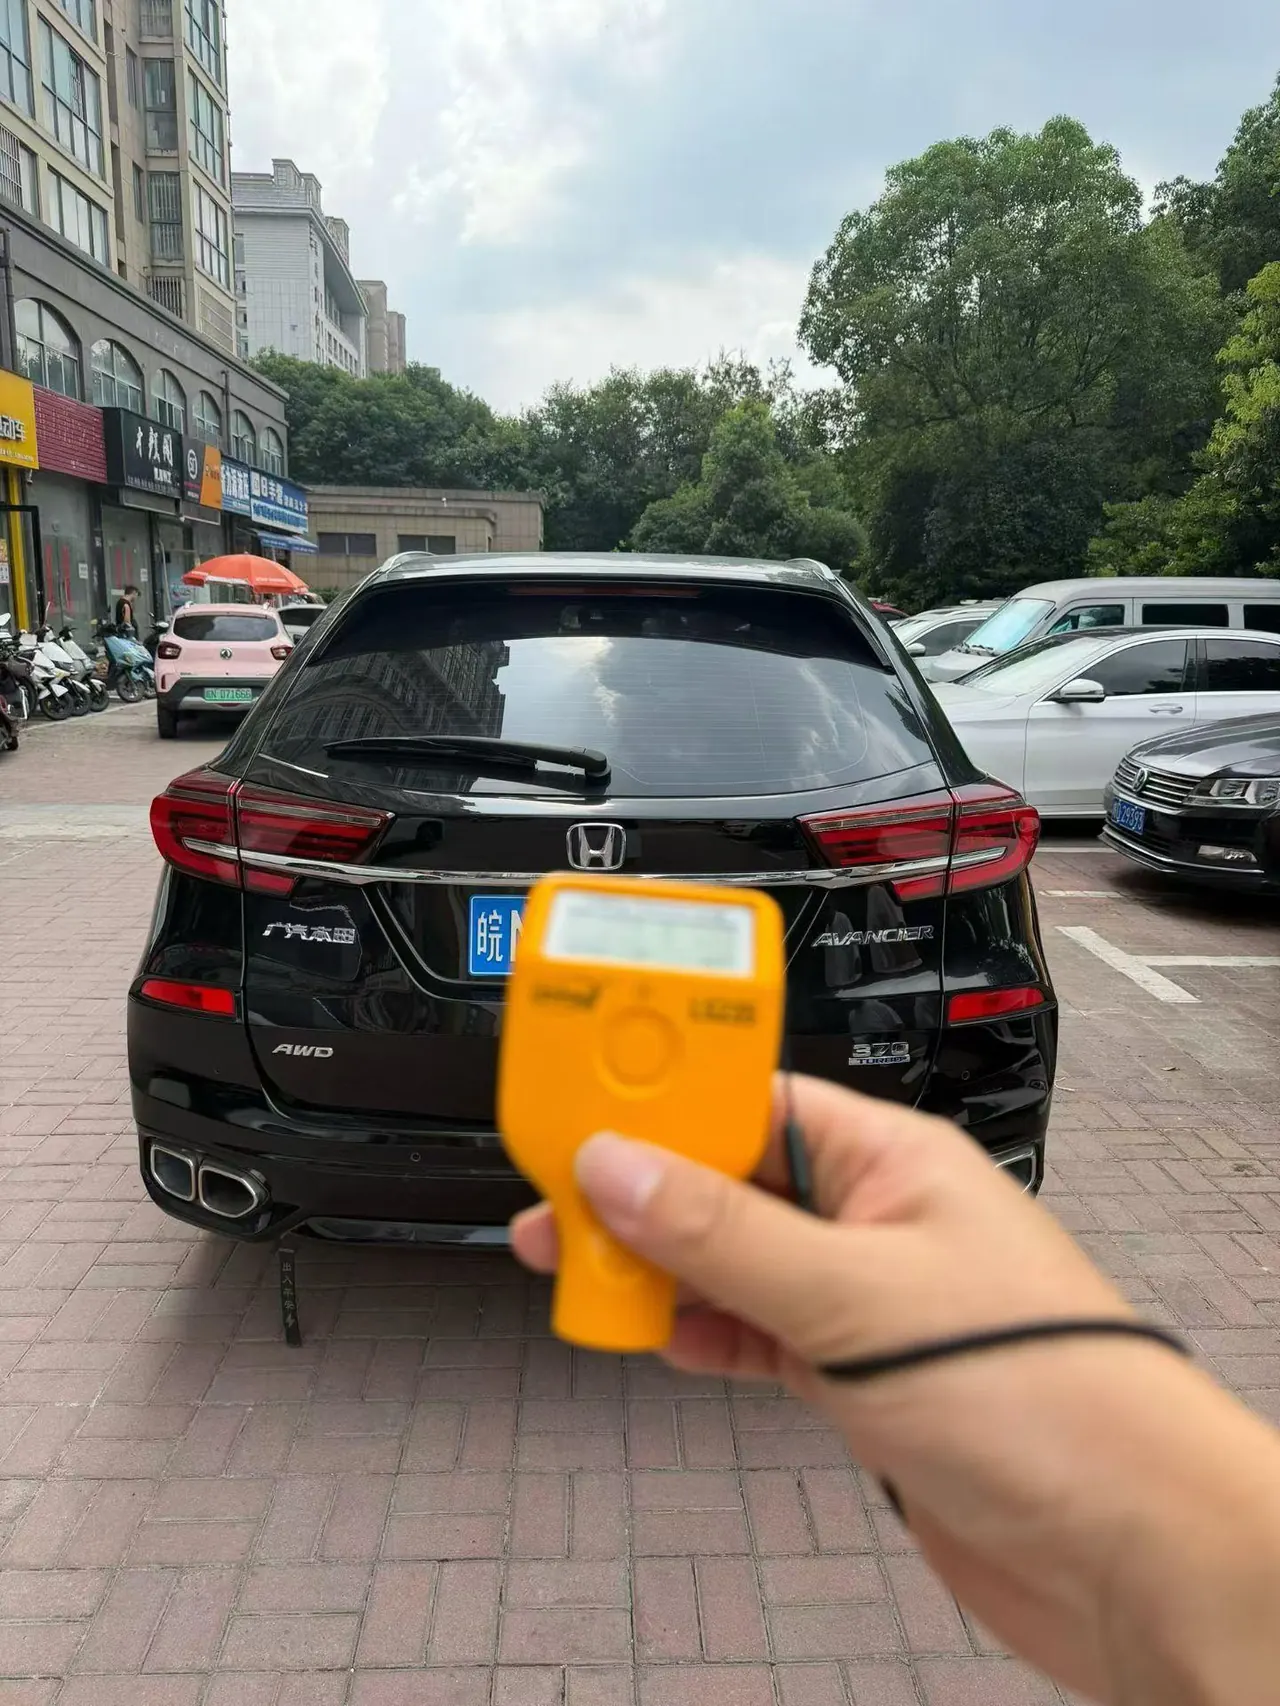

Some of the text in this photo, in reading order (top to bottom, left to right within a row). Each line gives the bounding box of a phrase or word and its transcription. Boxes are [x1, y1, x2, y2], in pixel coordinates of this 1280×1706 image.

[0, 414, 26, 443] 动车
[262, 922, 356, 944] 广汽本田
[811, 925, 934, 947] AVANCIER
[272, 1043, 334, 1058] AWD
[852, 1042, 910, 1058] 370
[282, 1262, 295, 1310] 出入平安
